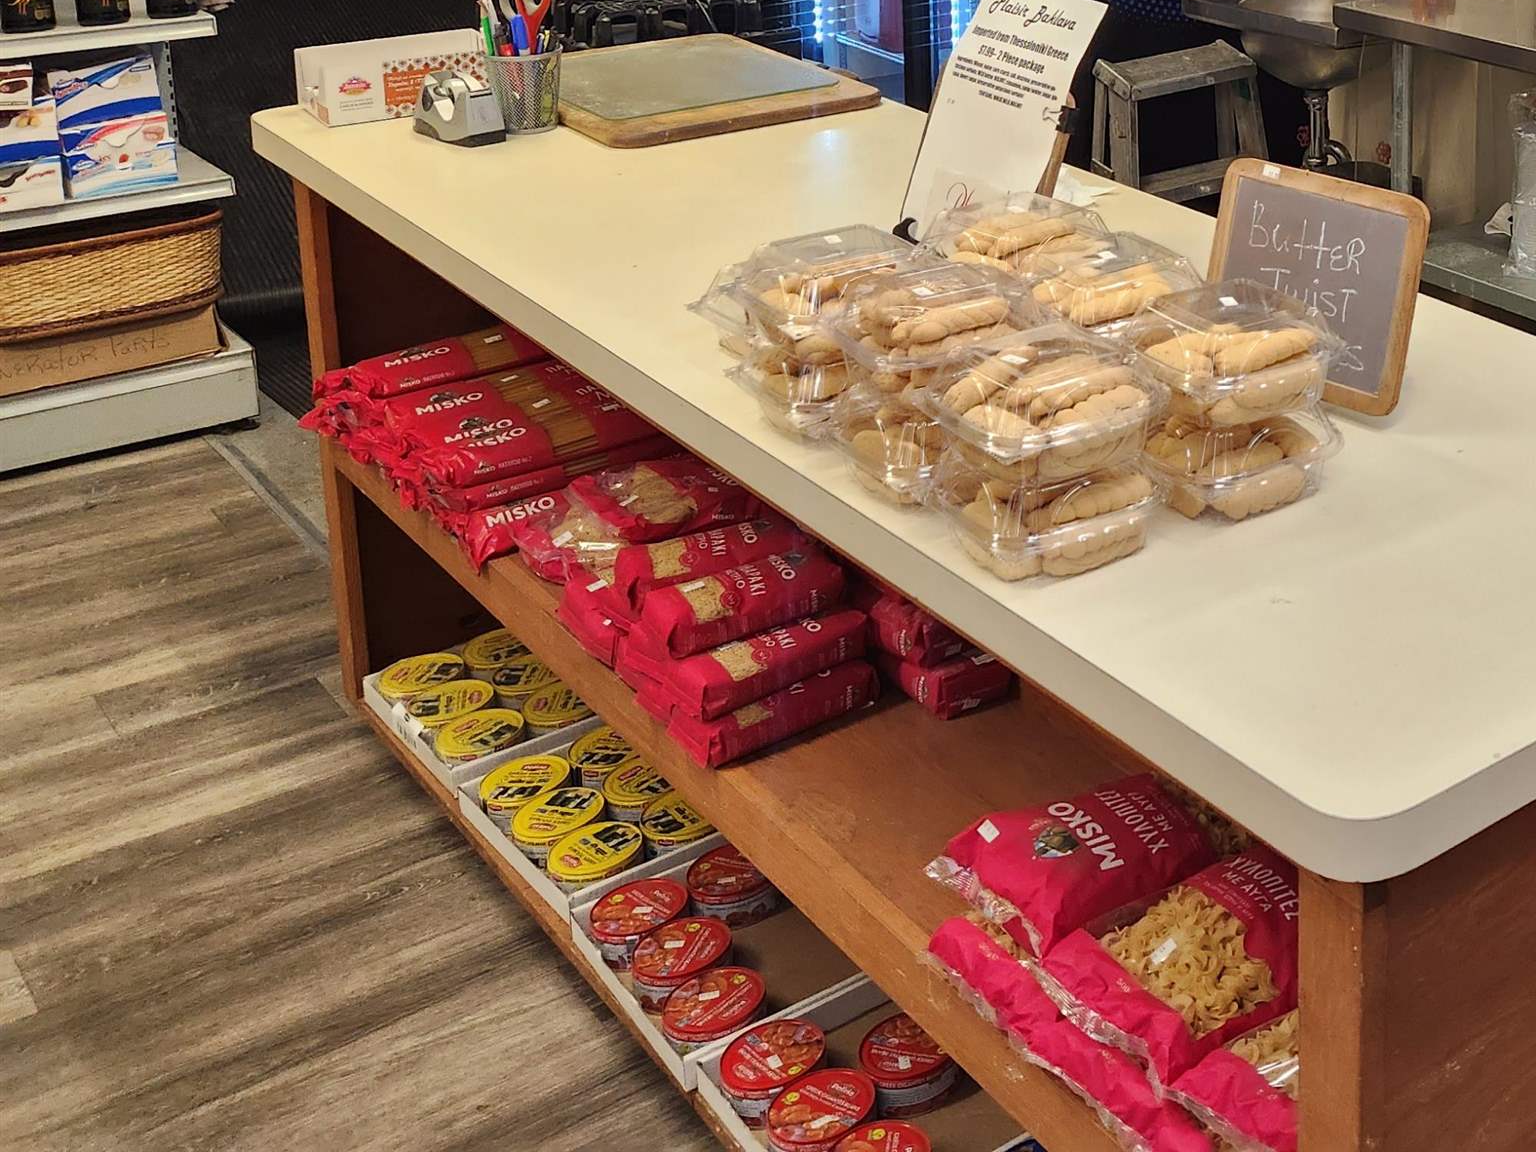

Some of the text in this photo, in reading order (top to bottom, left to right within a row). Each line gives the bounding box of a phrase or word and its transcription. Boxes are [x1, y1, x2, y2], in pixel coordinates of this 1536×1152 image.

[1023, 5, 1077, 30] Baklava
[1001, 51, 1020, 66] Piece
[1018, 58, 1045, 74] package
[1046, 43, 1070, 61] Greece
[384, 346, 450, 368] MISKO
[415, 392, 484, 416] MISKO
[486, 496, 555, 528] MISKO
[1047, 801, 1126, 872] MISKO
[1240, 881, 1273, 914] ΑΥΓΑ
